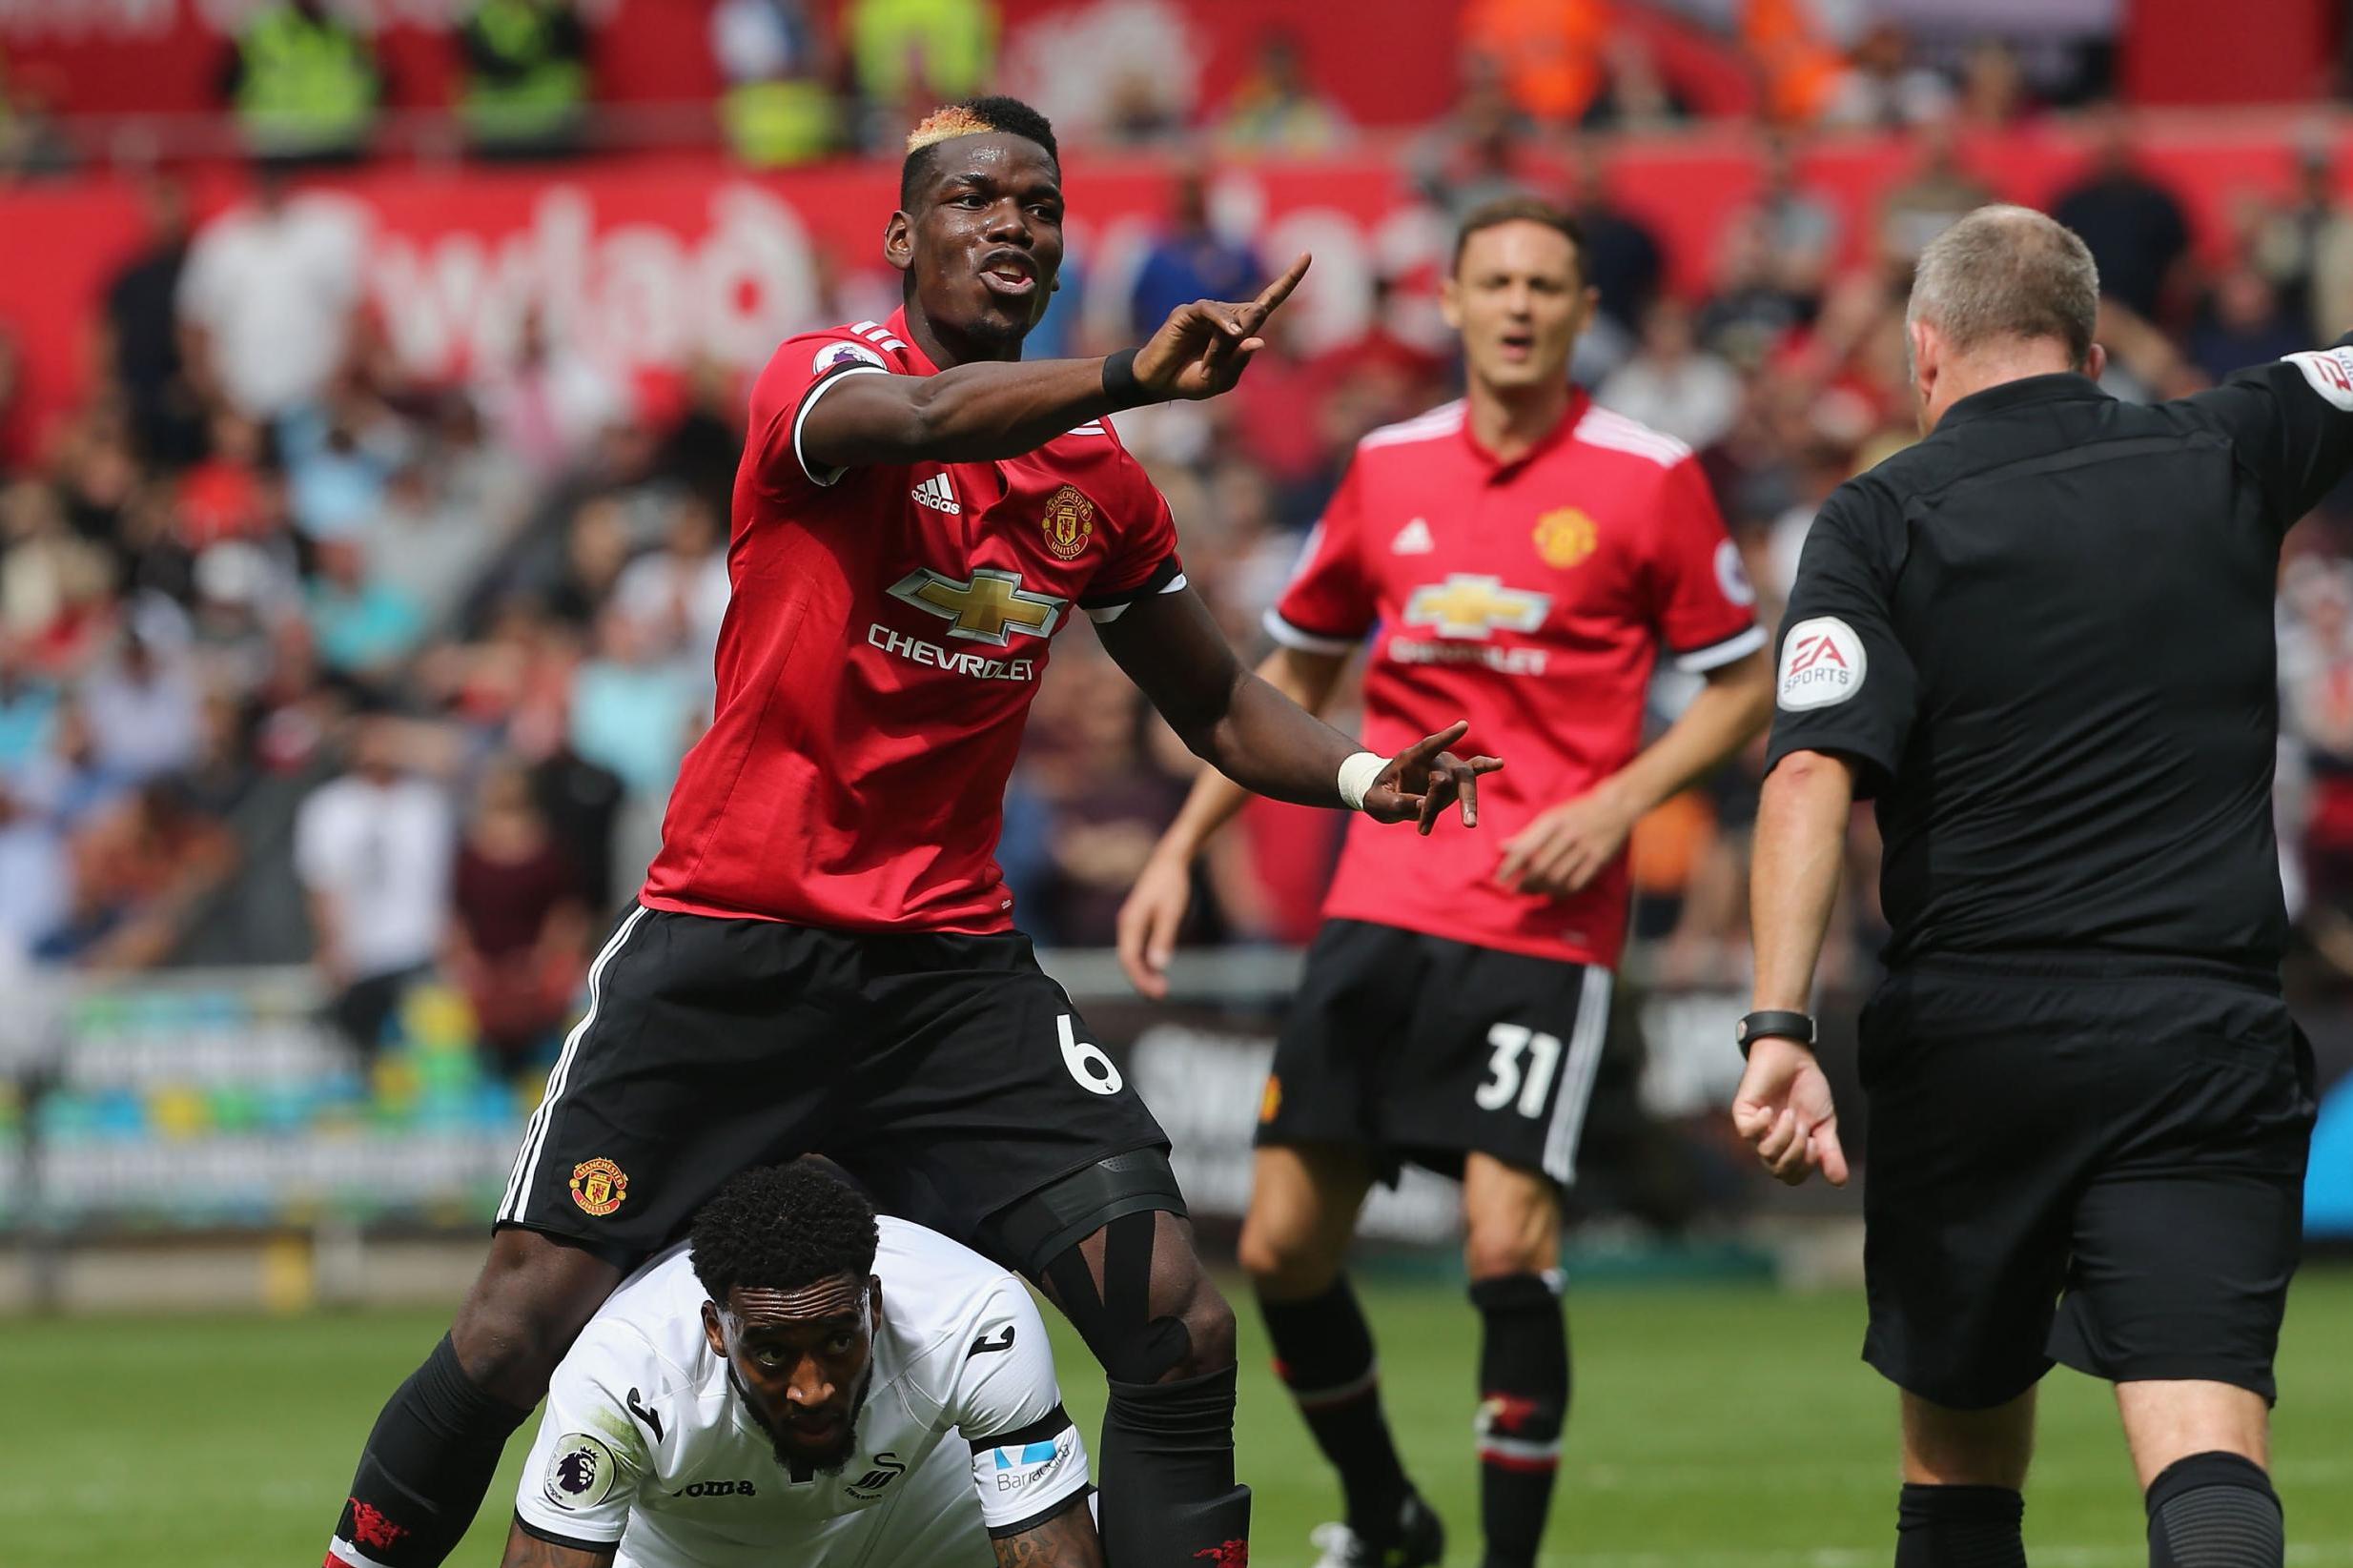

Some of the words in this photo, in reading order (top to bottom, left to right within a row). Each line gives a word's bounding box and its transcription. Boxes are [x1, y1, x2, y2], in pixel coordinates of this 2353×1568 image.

[911, 489, 960, 515] adidas
[1049, 490, 1089, 517] MANCHESTER
[1052, 540, 1080, 555] UNITED
[868, 622, 1033, 681] CHEVROLET
[1789, 635, 1847, 677] EA
[1783, 667, 1851, 695] SPORTS
[1056, 1014, 1123, 1095] 6
[1474, 1022, 1562, 1119] 31
[577, 1161, 624, 1185] MANCHESTER
[580, 1198, 611, 1212] UNITED
[671, 1479, 756, 1497] oma
